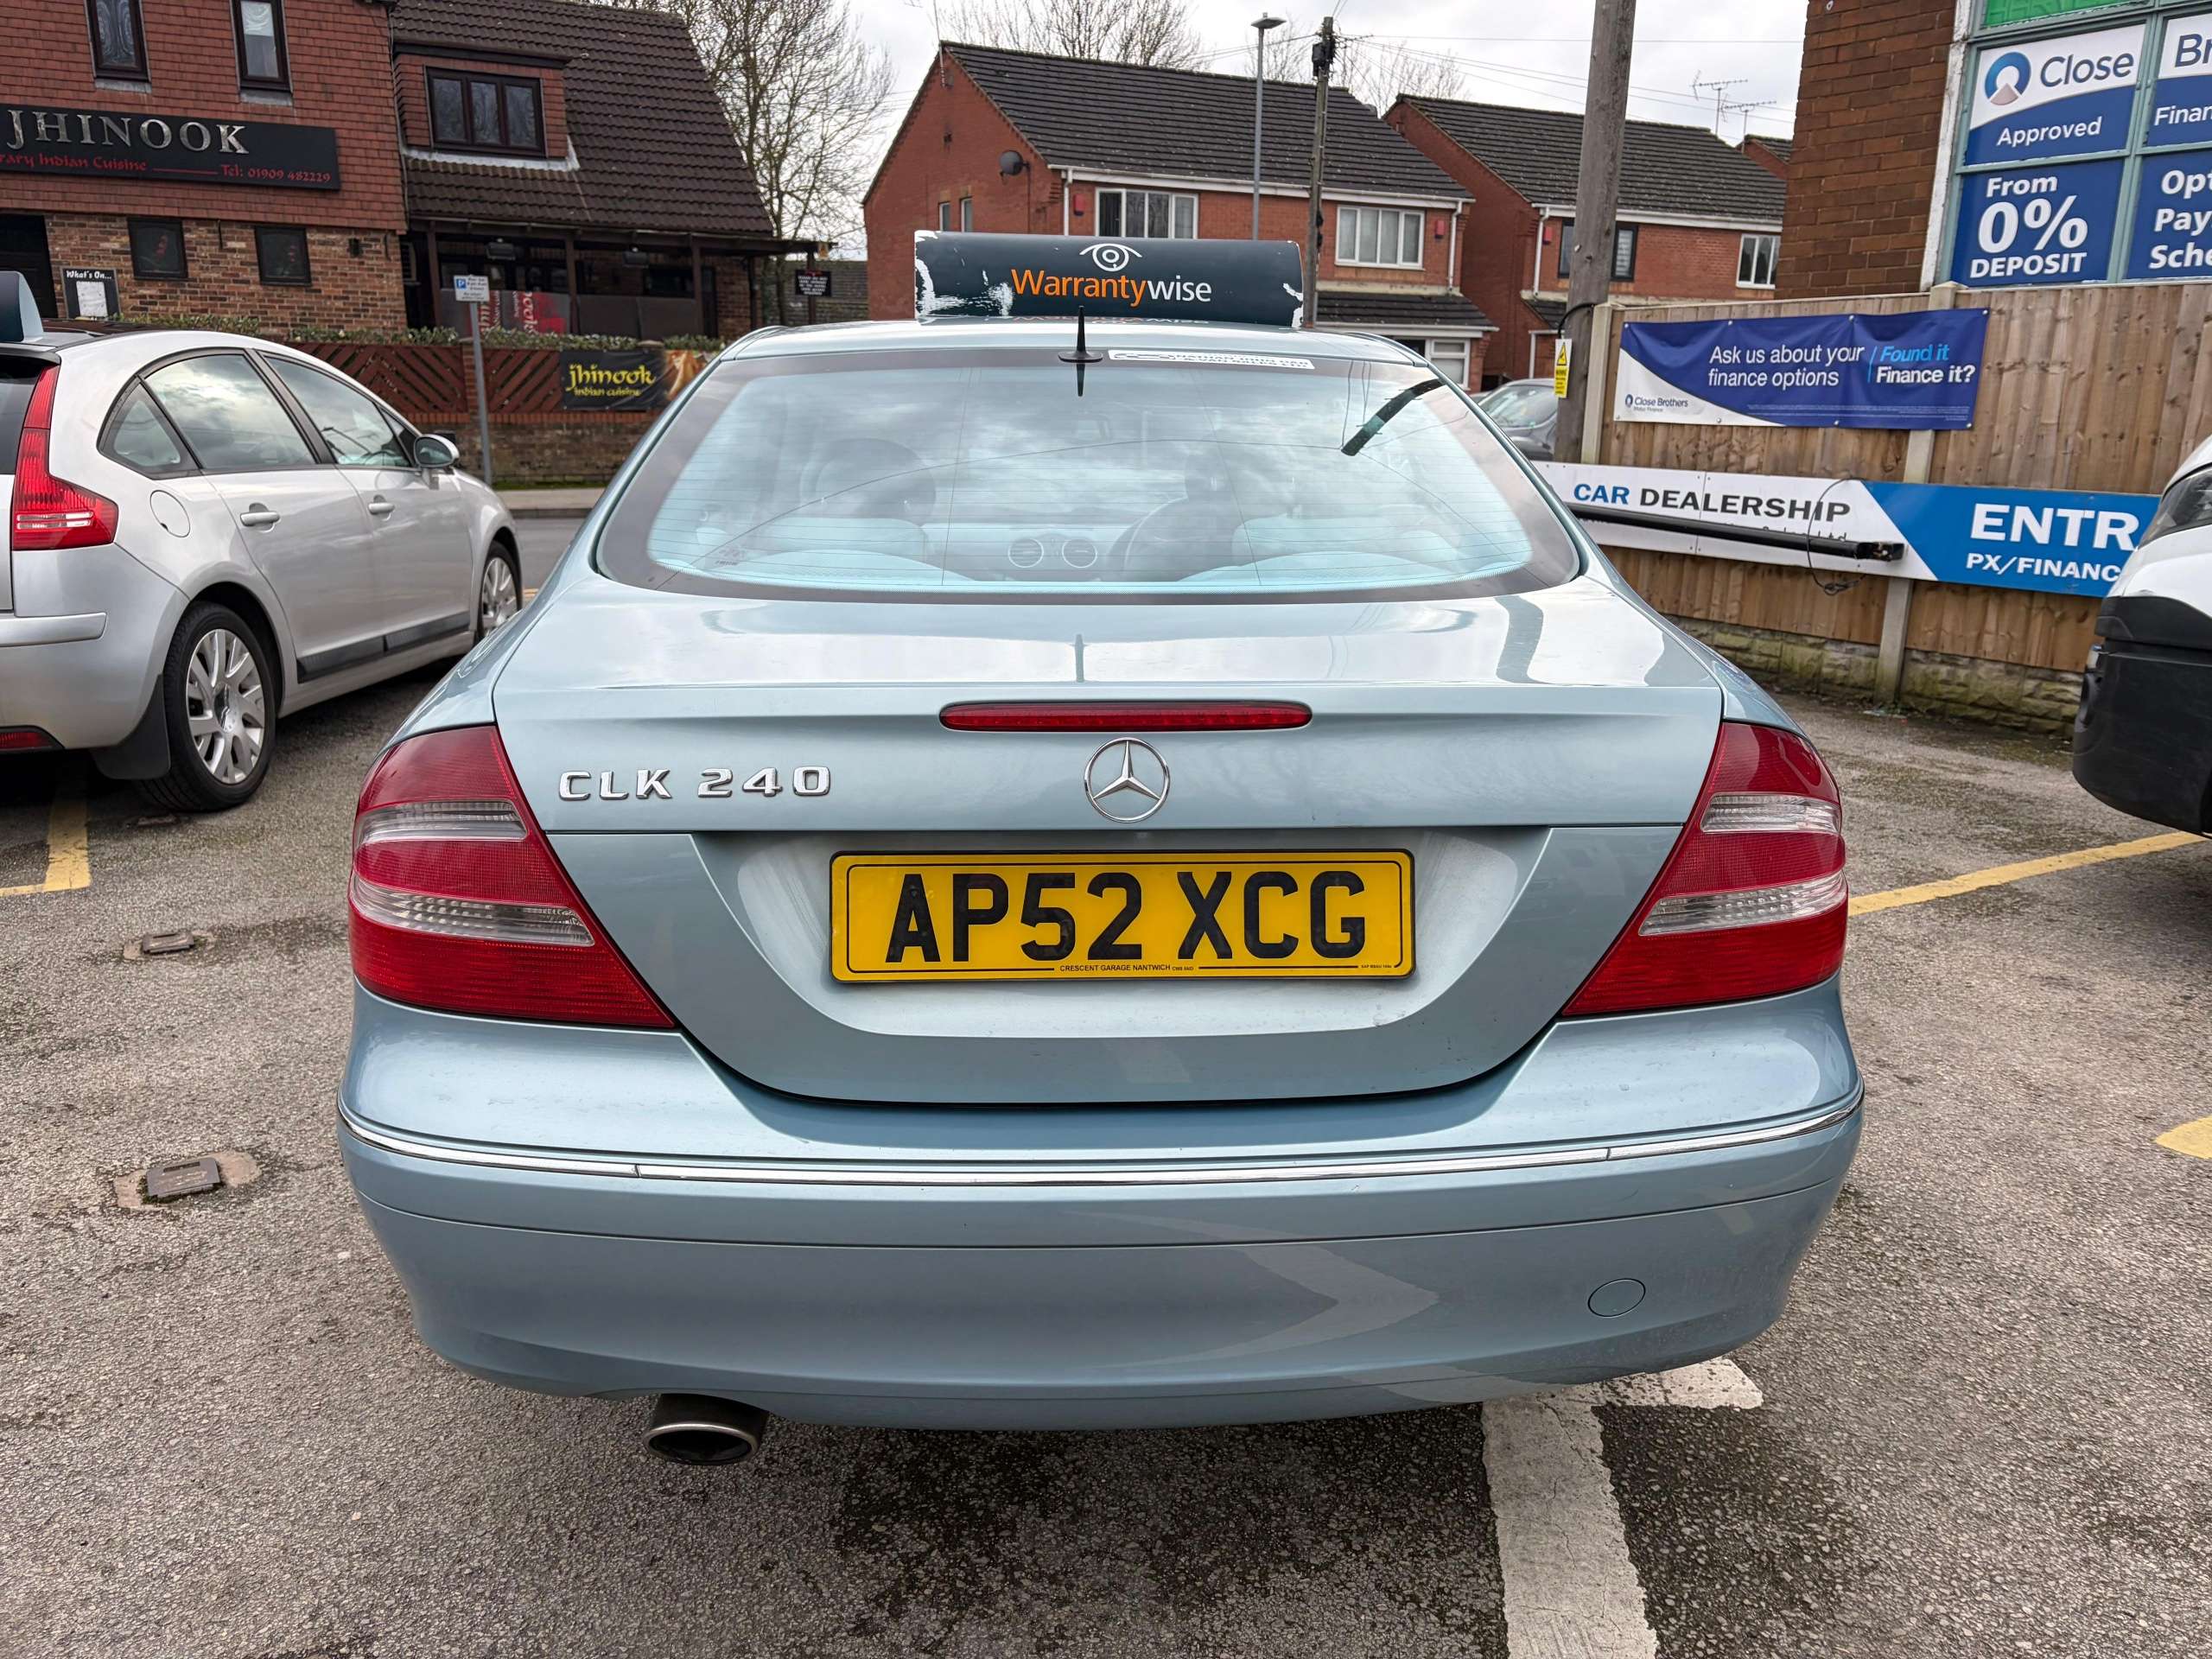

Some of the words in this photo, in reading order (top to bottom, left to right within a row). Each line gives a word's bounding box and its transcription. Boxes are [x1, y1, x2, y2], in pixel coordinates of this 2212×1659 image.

[2040, 53, 2134, 87] Close
[7, 110, 250, 155] JHINOOK
[1996, 116, 2102, 147] Approved
[39, 153, 88, 167] Indian
[92, 156, 147, 170] Cuisine
[1986, 175, 2058, 198] From
[1978, 195, 2088, 254] 0%
[2154, 208, 2212, 236] Pay
[66, 270, 92, 278] What's
[1970, 251, 2087, 278] DEPOSIT
[1011, 269, 1212, 308] Warrantywise
[1709, 346, 1741, 364] Ask
[1745, 349, 1765, 364] us
[1770, 345, 1821, 364] about
[1825, 346, 1866, 367] your
[1879, 344, 1933, 362] Found
[1936, 343, 1949, 361] it
[566, 363, 657, 391] jhinook
[1708, 367, 1768, 387] finance
[1772, 367, 1840, 391] options
[1876, 365, 1944, 384] Finance
[1948, 364, 1976, 384] it?
[1634, 397, 1656, 406] Close
[1657, 397, 1688, 408] Brothers
[1573, 483, 1630, 505] CAR
[1640, 487, 1851, 522] DEALERSHIP
[1970, 503, 2139, 551] ENTR
[558, 769, 672, 801] CLK
[698, 766, 831, 798] 240
[885, 872, 1143, 963] AP52
[1177, 870, 1366, 960] XCG
